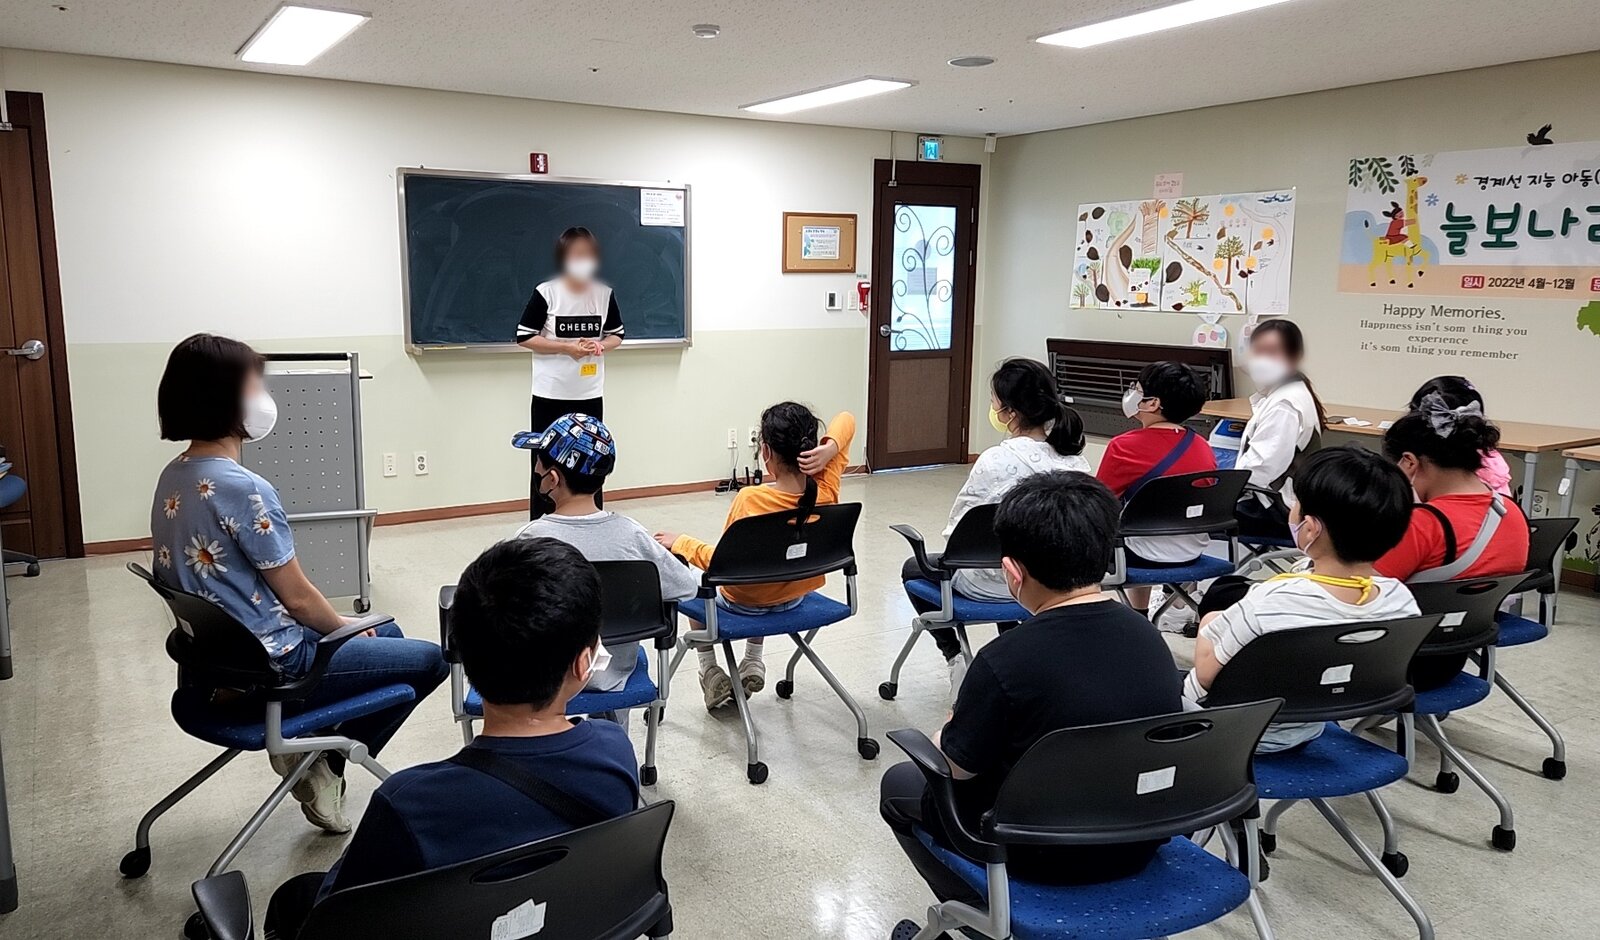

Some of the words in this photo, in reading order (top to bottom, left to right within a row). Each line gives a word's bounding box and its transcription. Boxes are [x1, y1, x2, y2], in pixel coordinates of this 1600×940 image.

[1473, 175, 1522, 190] 경계선
[1527, 172, 1556, 188] 지능
[1488, 277, 1525, 289] 2022년
[1528, 278, 1576, 290] 4월~12월
[1383, 303, 1426, 319] Happy
[1430, 305, 1506, 321] Memories.
[559, 322, 600, 332] CHEERS
[1360, 319, 1412, 330] Happiness
[1472, 325, 1504, 336] thing
[1506, 328, 1528, 336] you
[1407, 335, 1469, 345] experience
[1406, 345, 1435, 355] thing
[1437, 349, 1457, 357] you
[1460, 349, 1519, 360] remember
